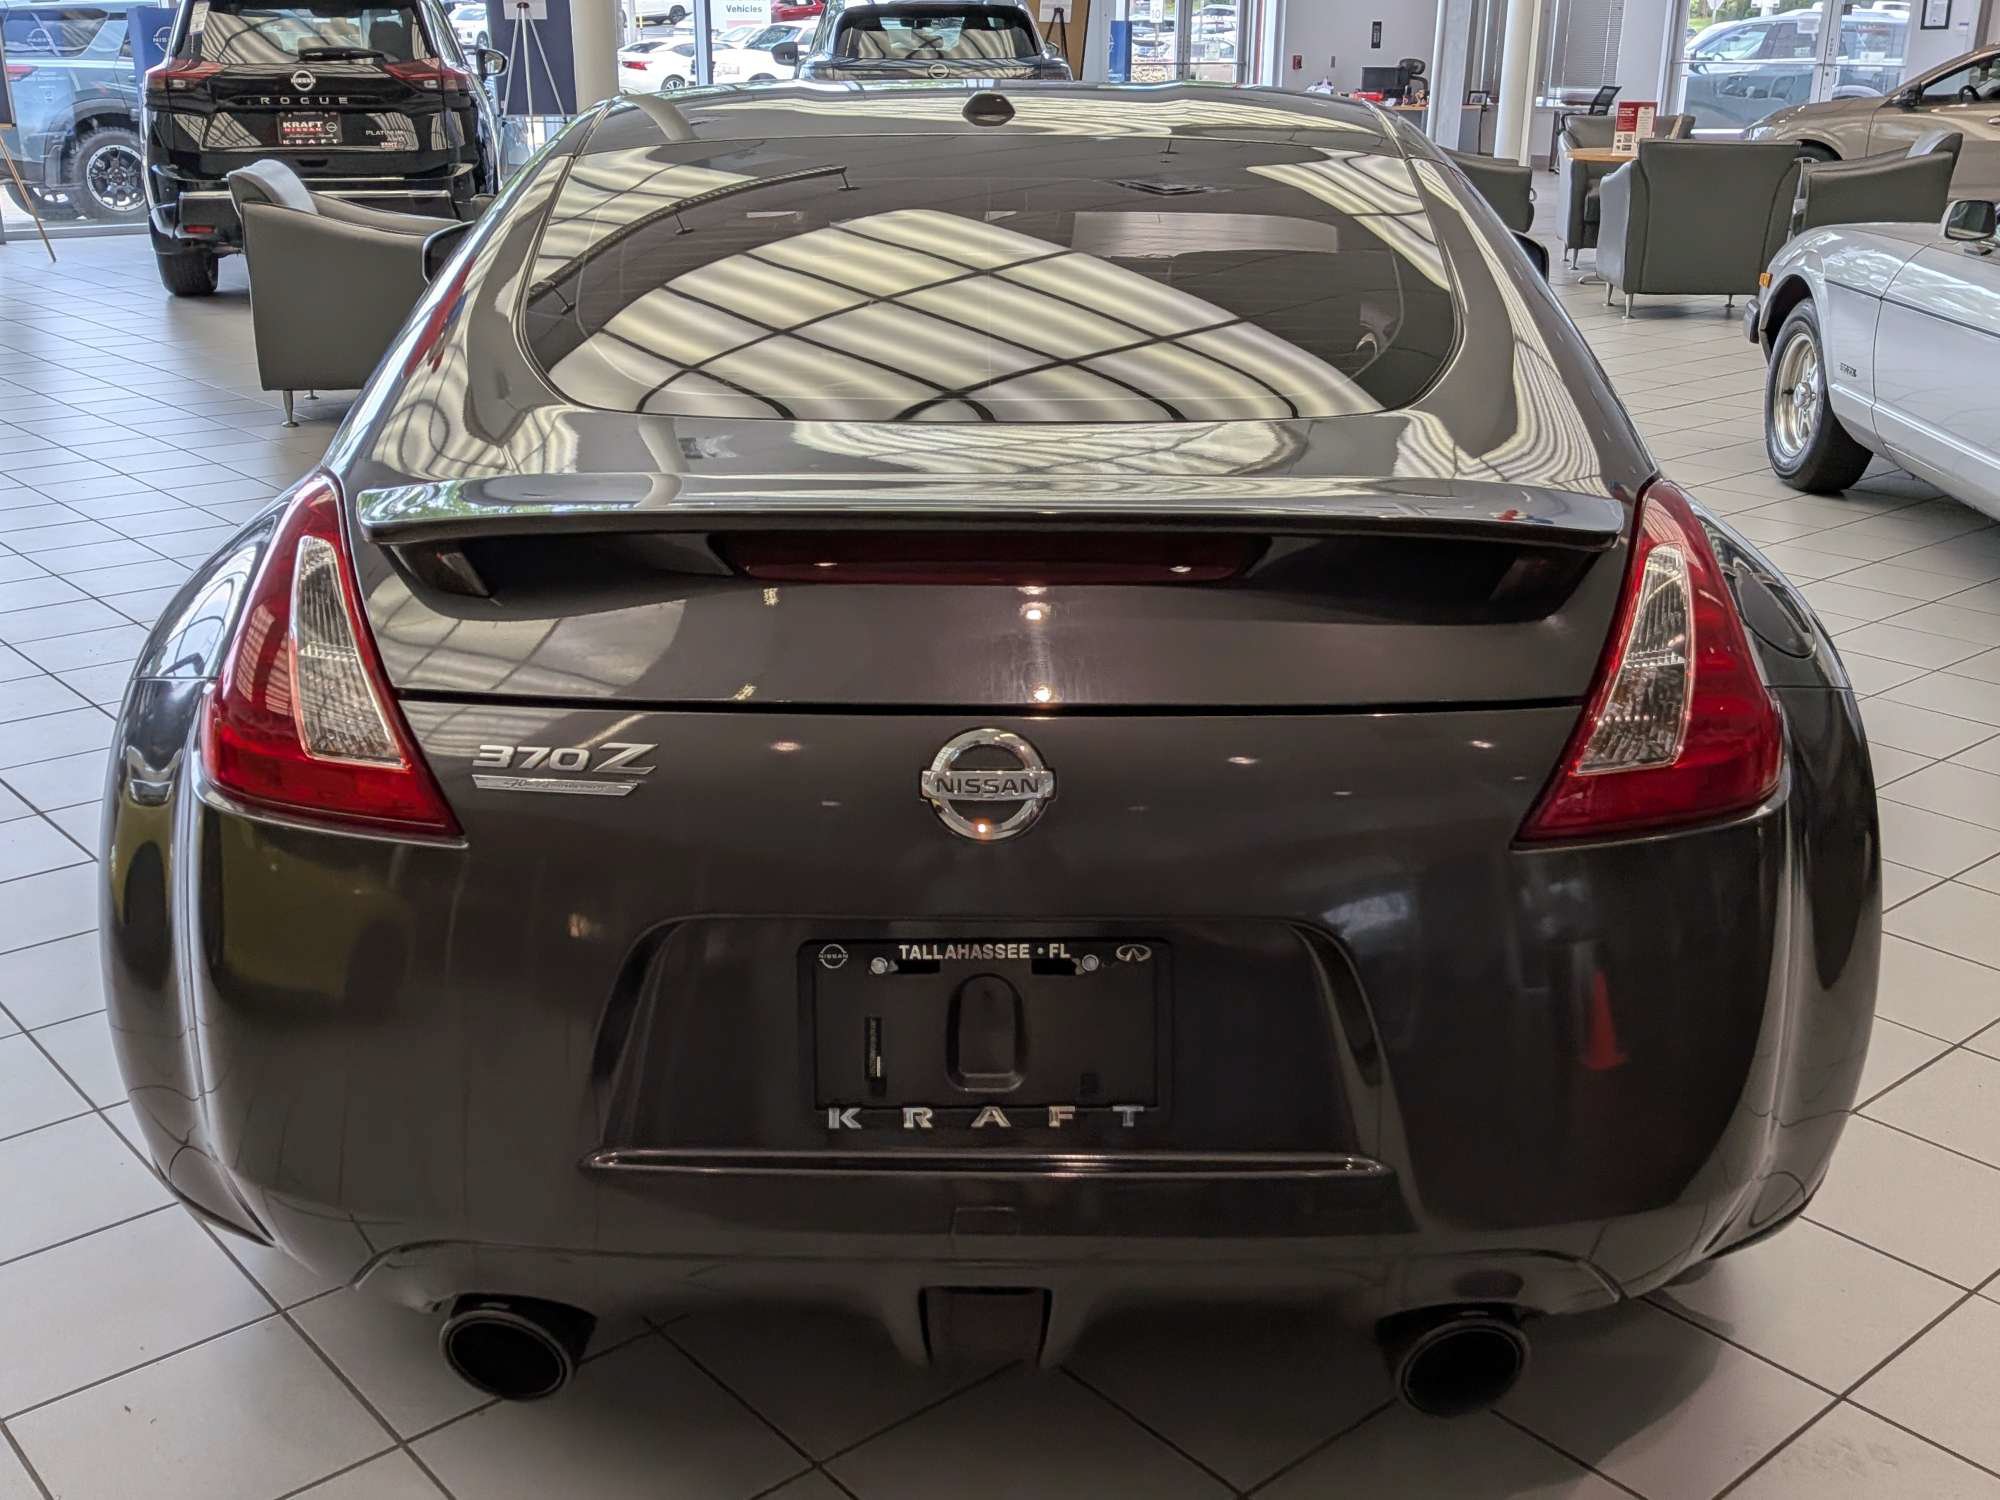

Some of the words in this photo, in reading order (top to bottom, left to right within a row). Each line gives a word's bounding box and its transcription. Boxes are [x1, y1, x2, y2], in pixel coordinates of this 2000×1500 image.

[726, 4, 763, 13] Vehicles
[472, 742, 658, 774] 370Z
[935, 777, 1039, 794] NISSAN
[899, 944, 1030, 959] TALLAHASSEE
[1049, 943, 1071, 959] FL
[827, 1105, 1145, 1130] KRAFT
